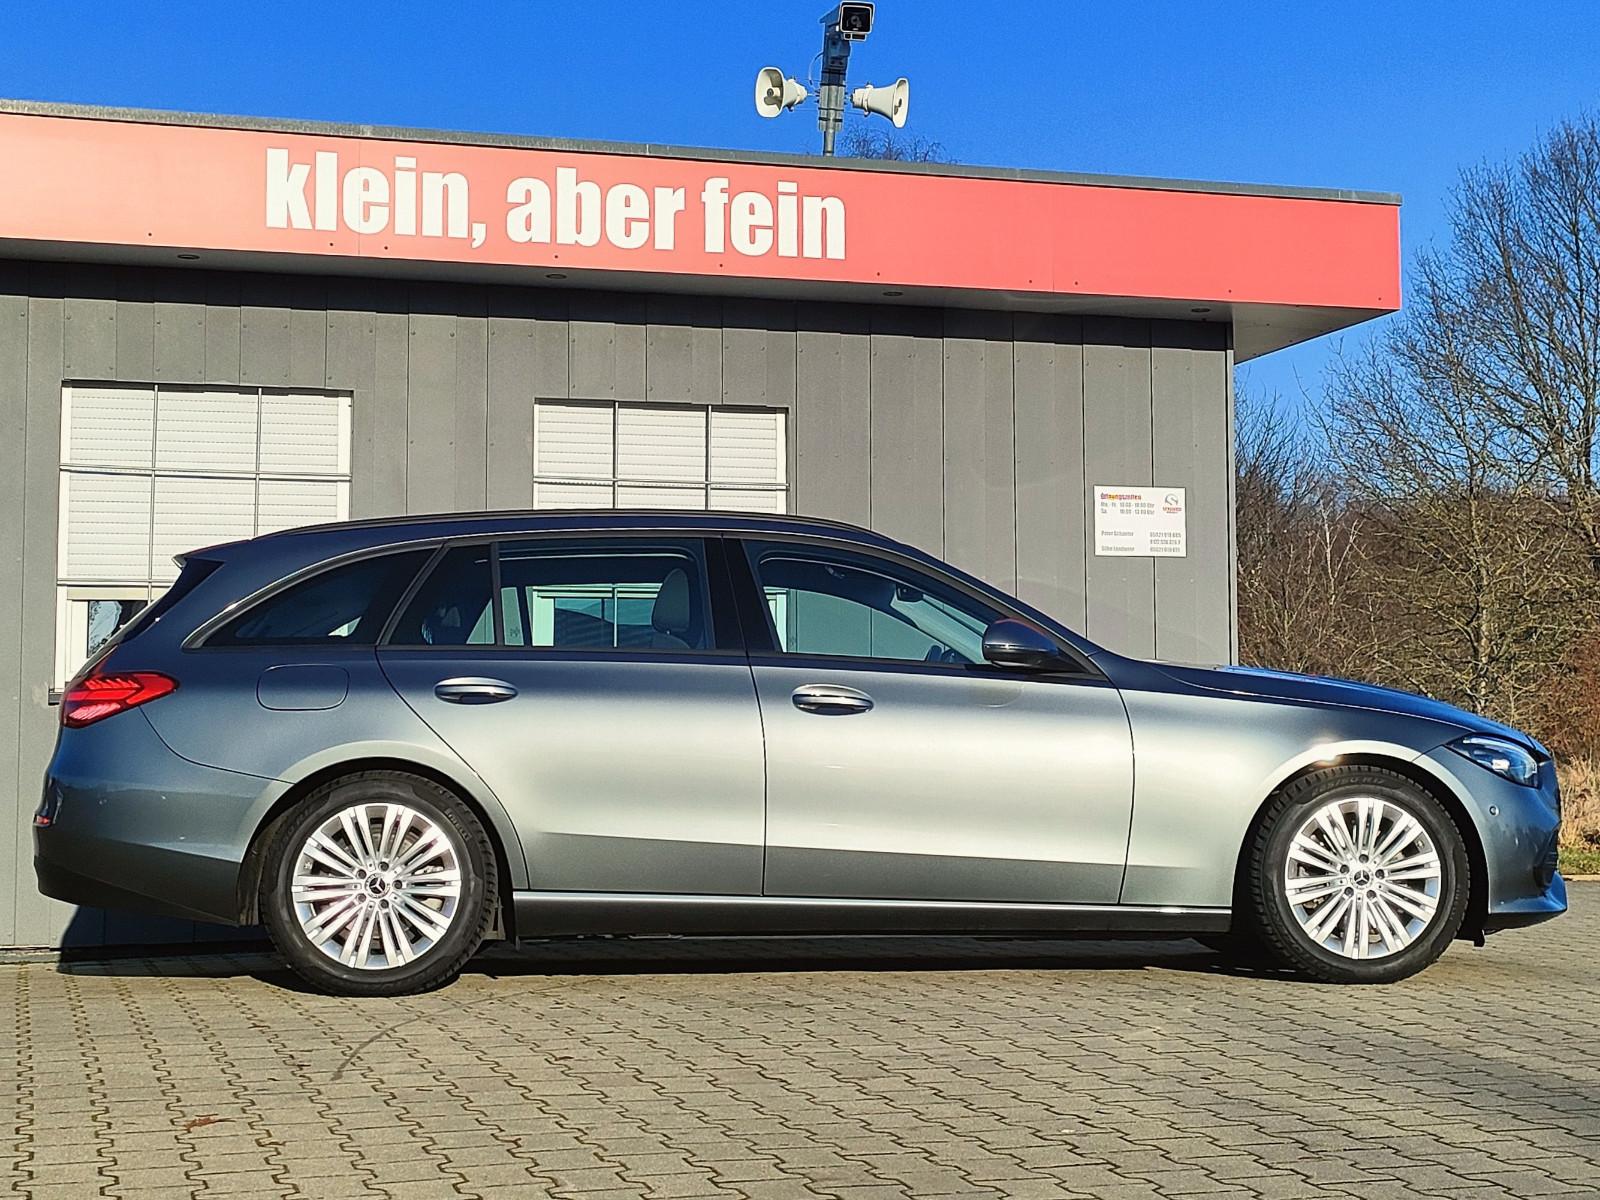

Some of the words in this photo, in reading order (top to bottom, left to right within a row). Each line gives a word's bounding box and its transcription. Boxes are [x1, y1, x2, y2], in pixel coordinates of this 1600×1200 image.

[266, 147, 487, 249] klein,
[506, 166, 686, 250] aber
[701, 177, 846, 261] fein
